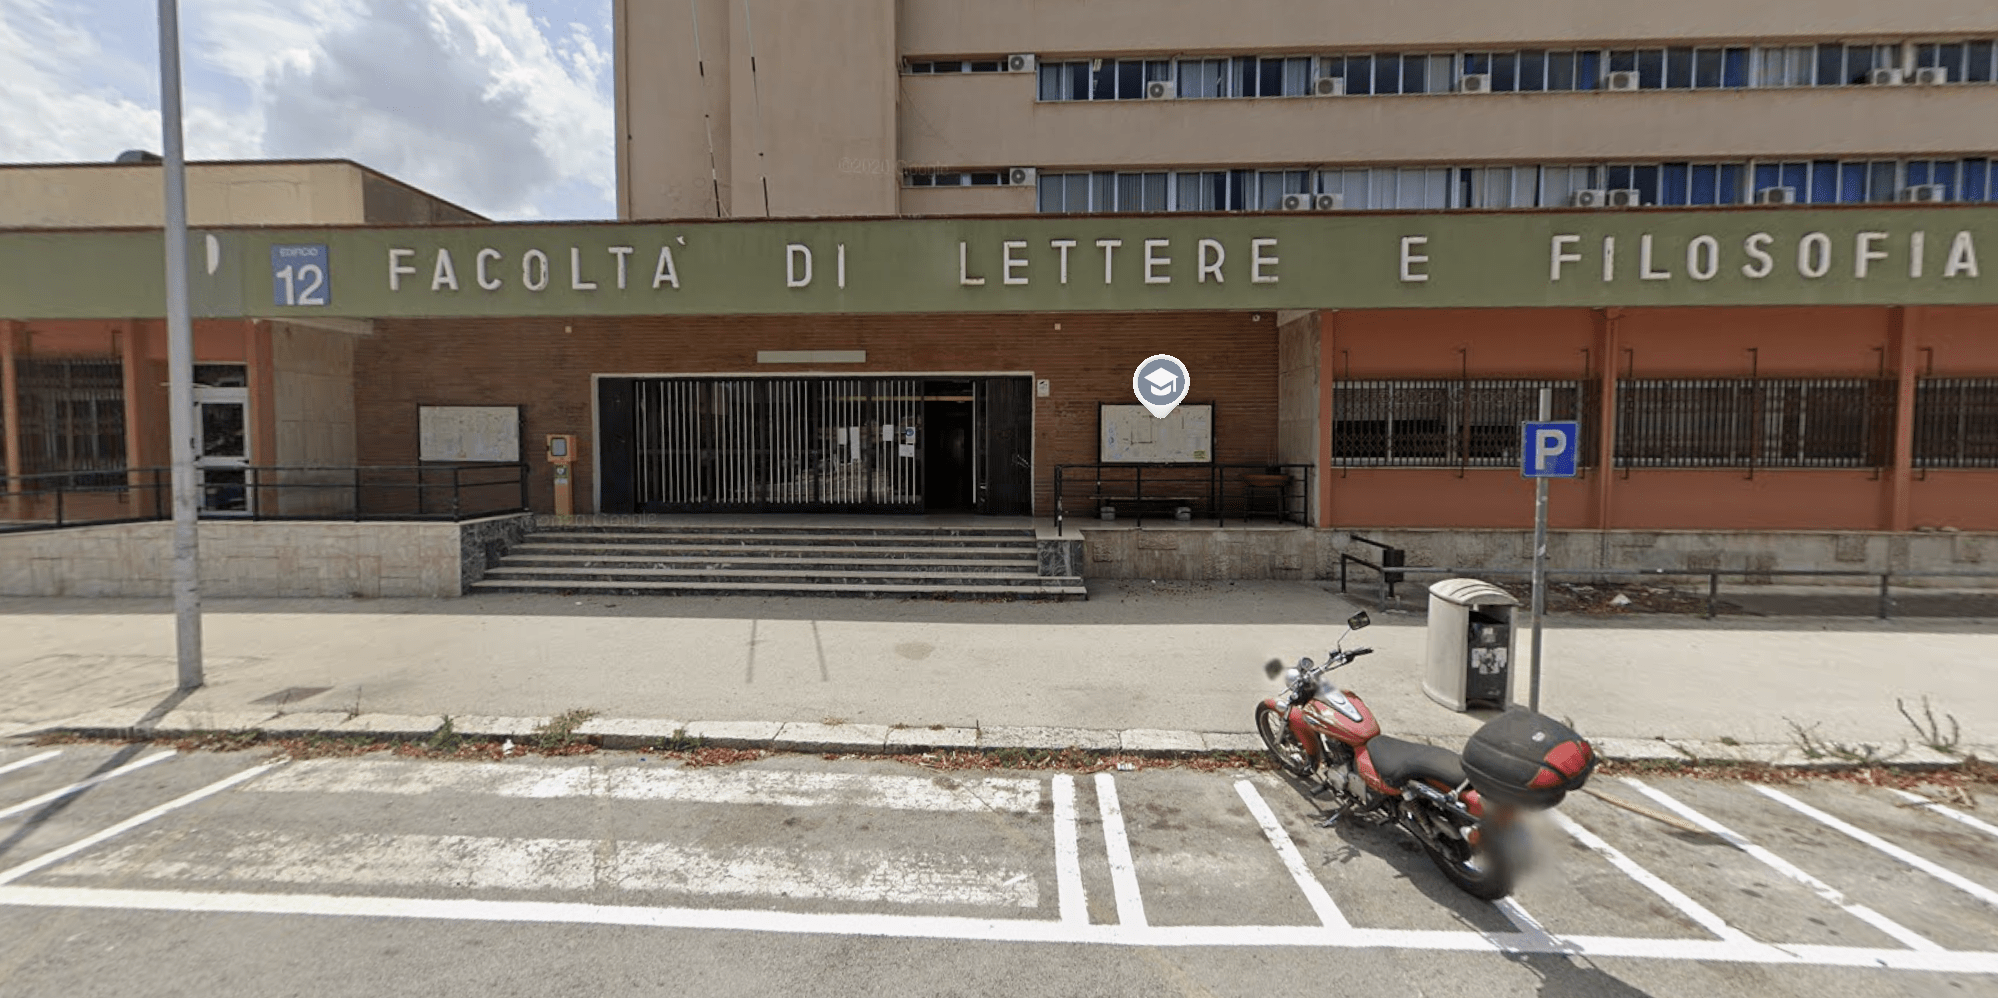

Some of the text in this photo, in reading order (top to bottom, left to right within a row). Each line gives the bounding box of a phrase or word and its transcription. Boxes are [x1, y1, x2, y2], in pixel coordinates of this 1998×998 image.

[389, 231, 1979, 291] FACOLTÀ DI LETTERE E FILOSOFIA
[276, 264, 324, 306] 12
[1535, 429, 1567, 470] P
